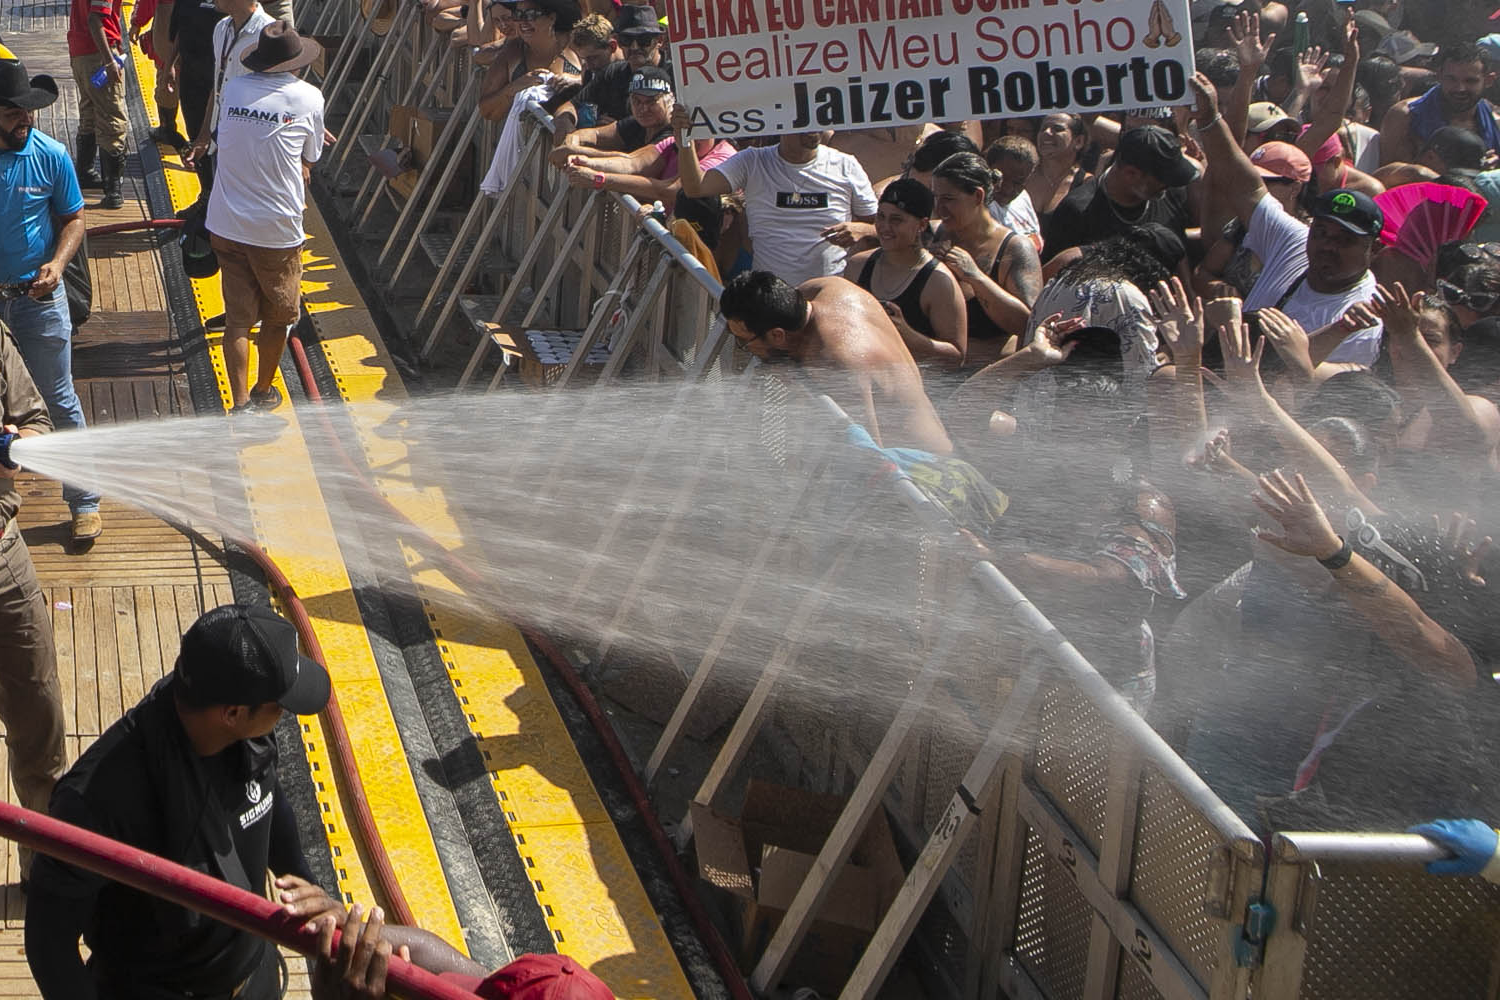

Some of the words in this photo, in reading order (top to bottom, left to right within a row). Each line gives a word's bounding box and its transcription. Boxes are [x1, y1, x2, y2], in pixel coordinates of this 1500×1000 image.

[680, 33, 850, 87] Realize
[859, 24, 961, 73] Meu
[975, 10, 1137, 63] Sonho
[227, 106, 279, 124] PARANÁ
[793, 75, 952, 131] Jaizer
[969, 57, 1187, 115] Roberto
